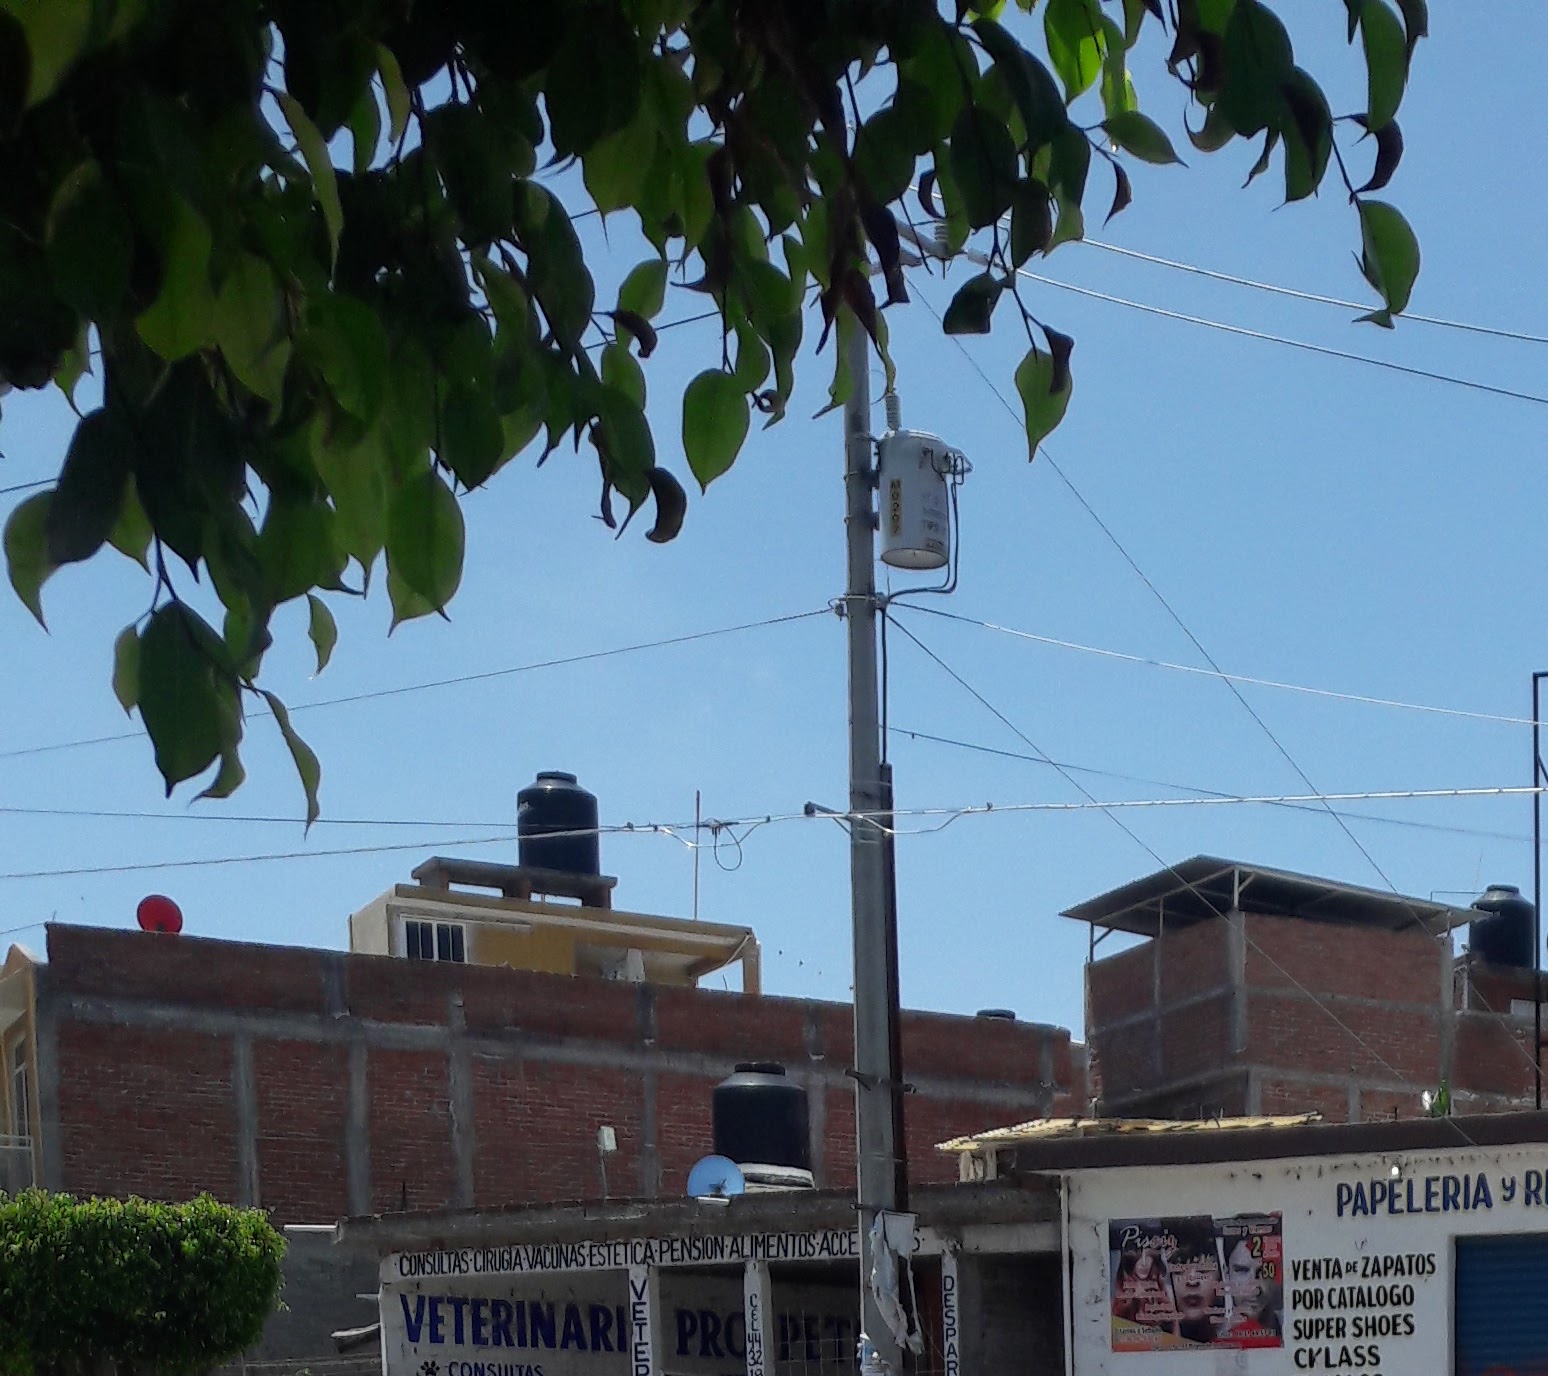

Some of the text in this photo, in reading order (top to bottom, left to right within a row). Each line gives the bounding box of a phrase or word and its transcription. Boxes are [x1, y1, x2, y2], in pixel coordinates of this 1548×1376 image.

[1336, 1172, 1494, 1217] PAPELERIA
[400, 1251, 469, 1277] CONSULTAS
[525, 1244, 586, 1270] VACUNAS
[658, 1235, 724, 1262] PENSION
[731, 1231, 816, 1259] ALIMENTOS
[1292, 1253, 1436, 1282] VENTA DE ZAPATOS
[1292, 1284, 1415, 1311] POR CATALOGO
[400, 1294, 627, 1352] VETERINARI
[1293, 1316, 1347, 1340] SUPER
[1352, 1313, 1415, 1338] SHOES
